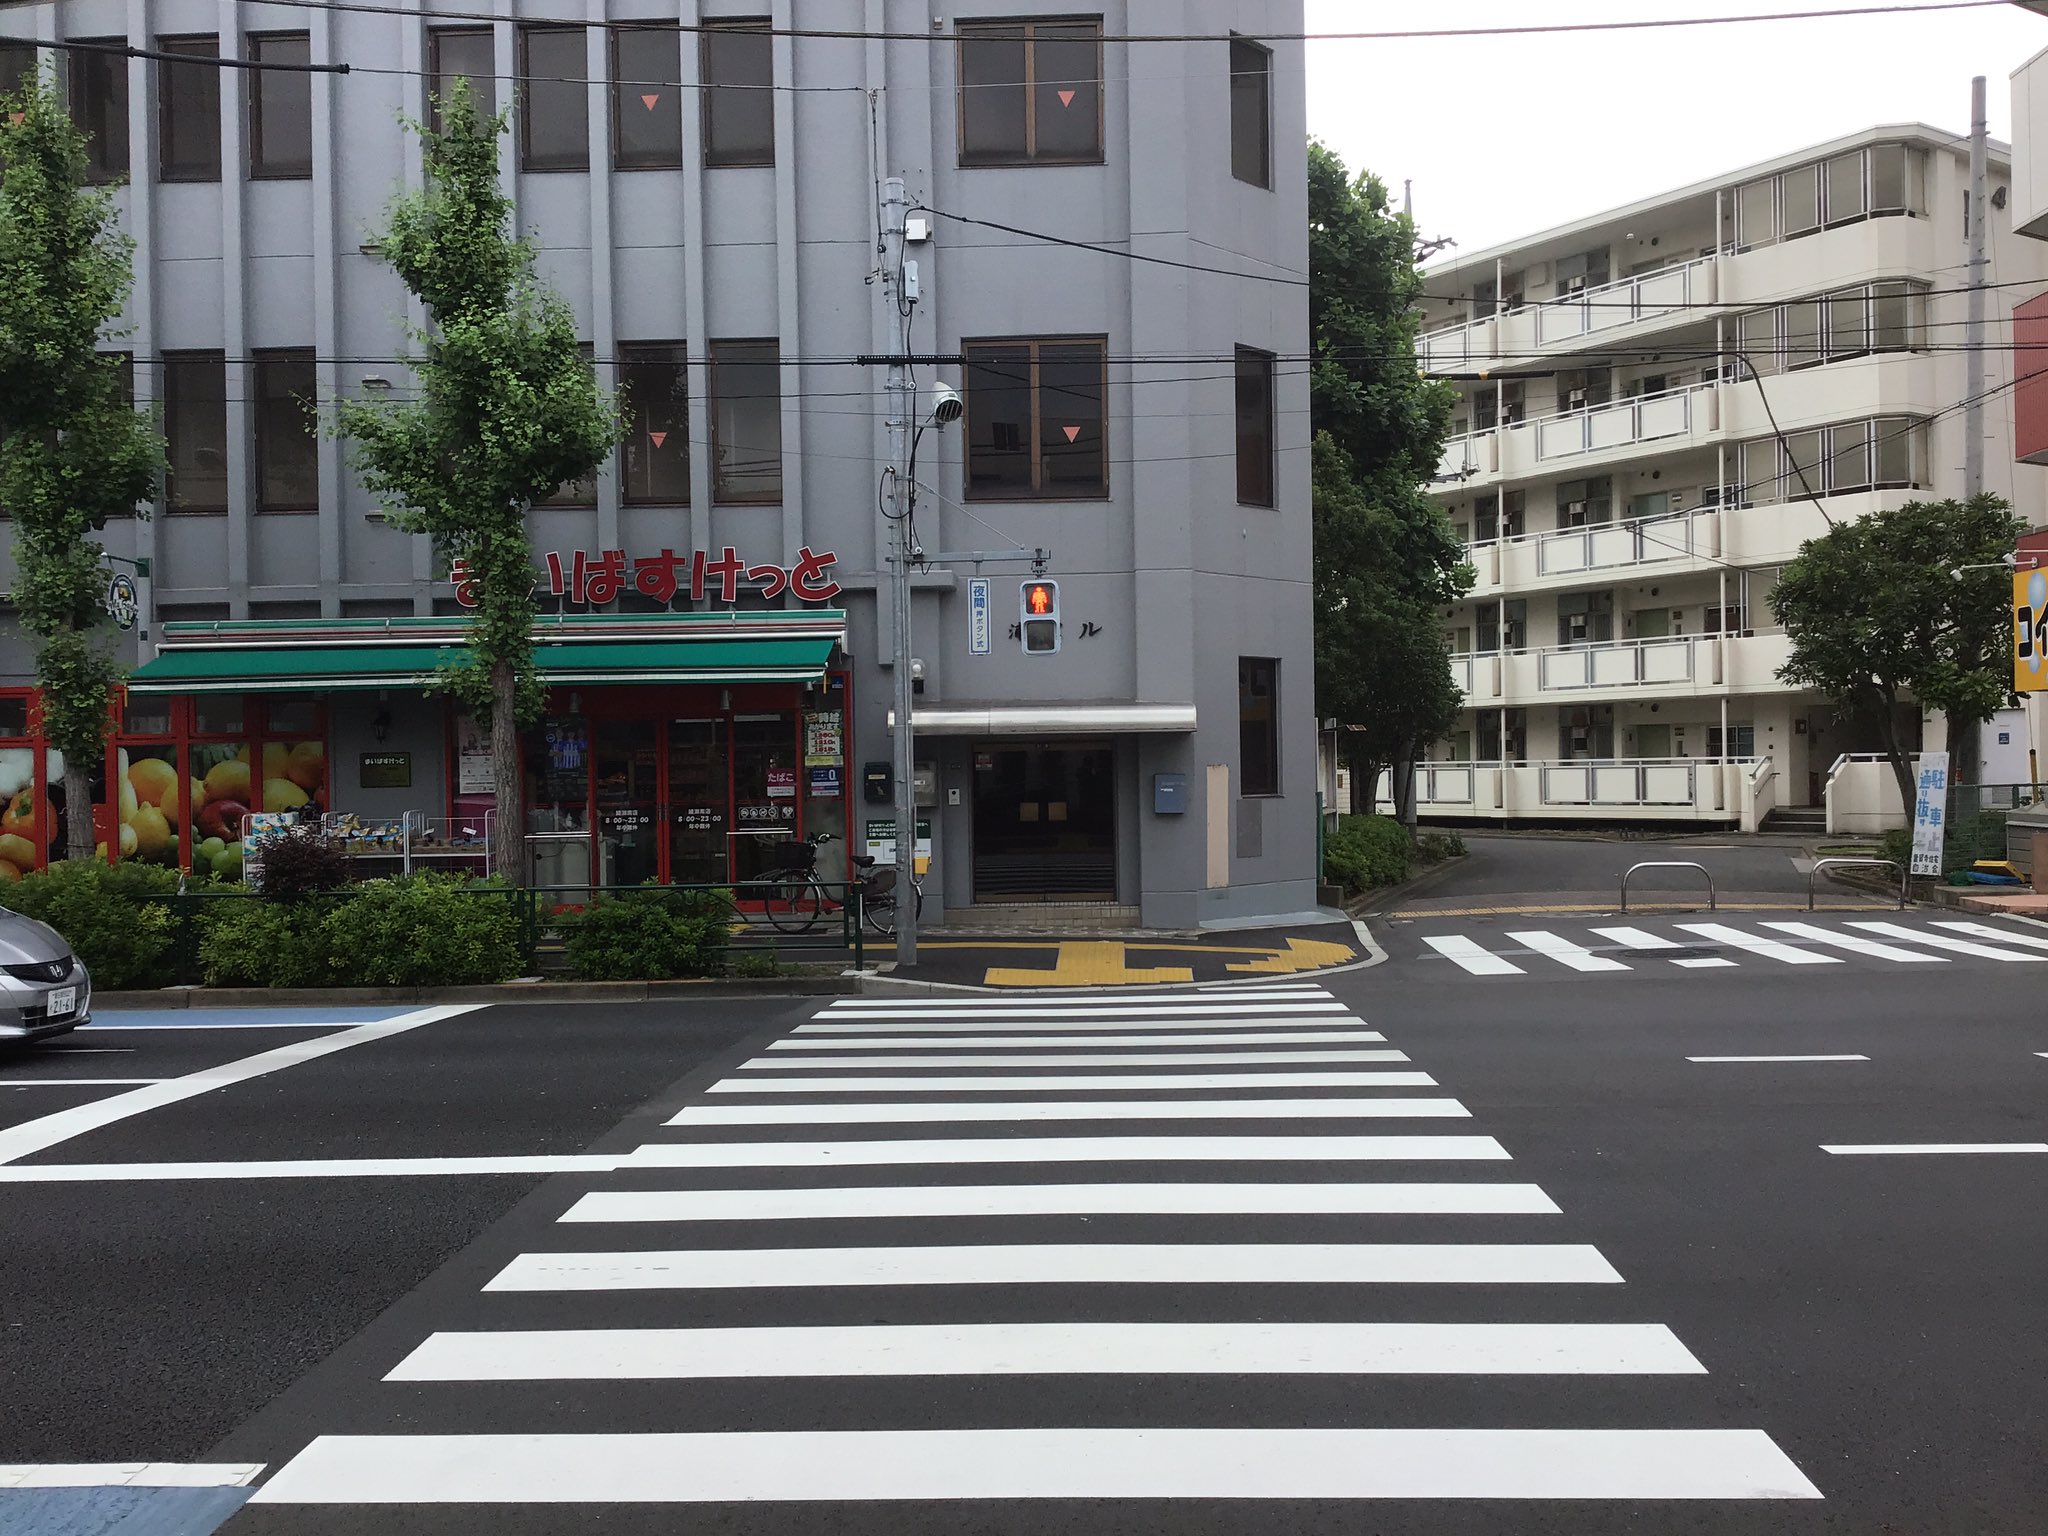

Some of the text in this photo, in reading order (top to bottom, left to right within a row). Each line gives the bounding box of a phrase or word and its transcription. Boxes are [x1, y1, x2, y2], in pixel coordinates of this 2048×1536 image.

[1991, 185, 2007, 209] 4
[767, 772, 794, 783] たばこ
